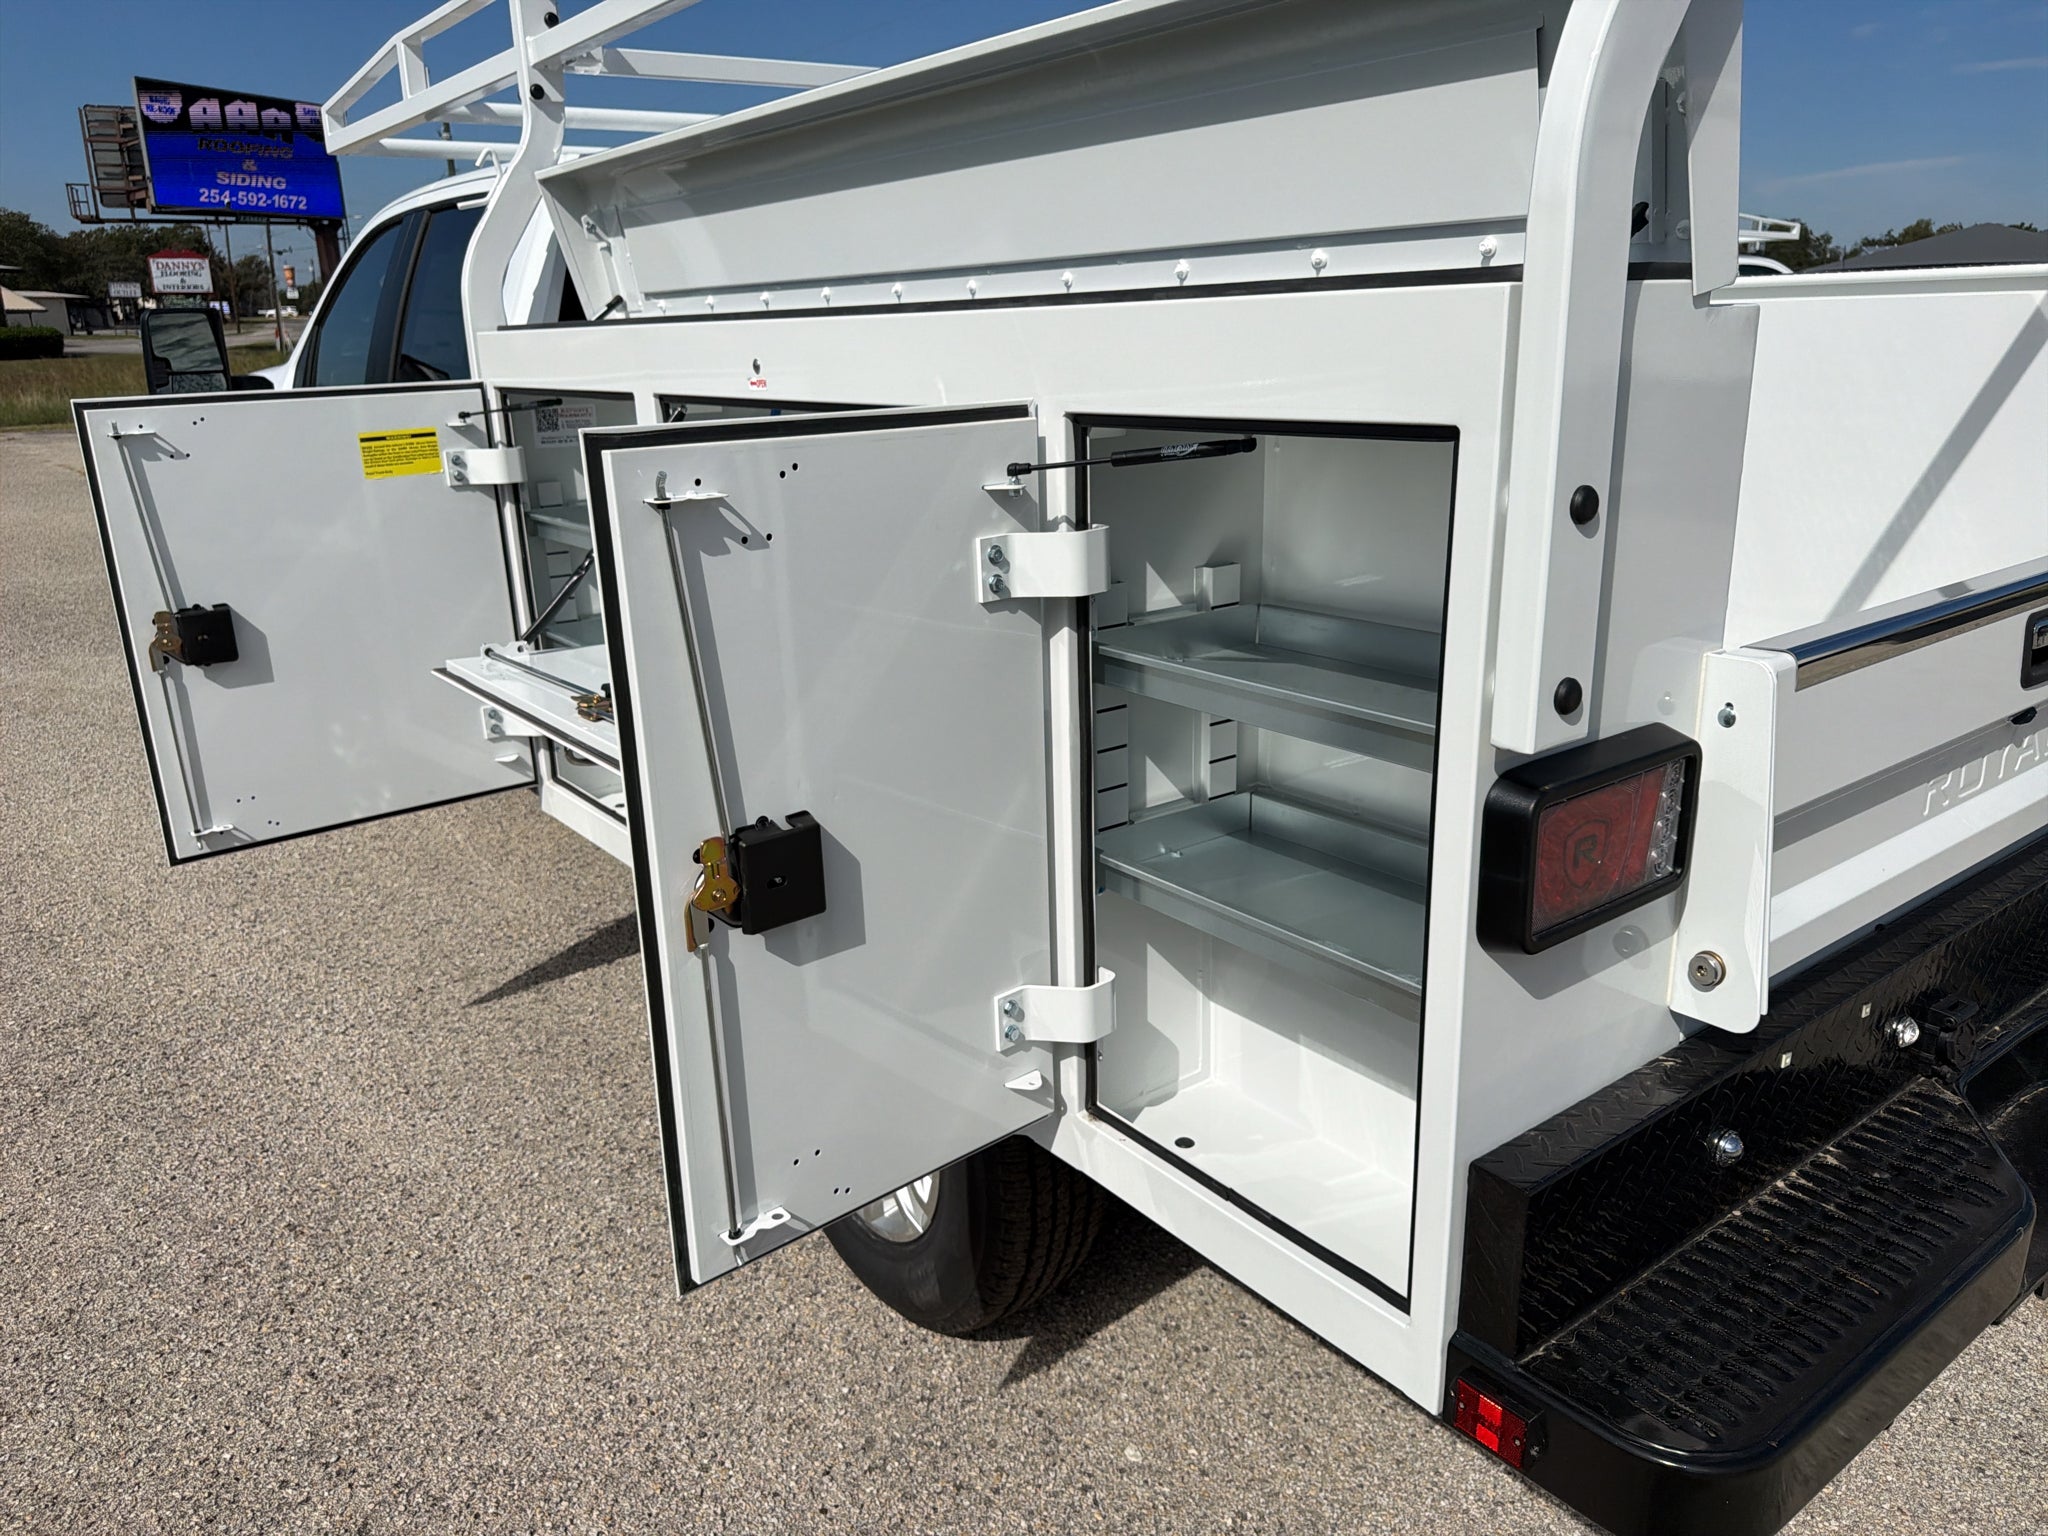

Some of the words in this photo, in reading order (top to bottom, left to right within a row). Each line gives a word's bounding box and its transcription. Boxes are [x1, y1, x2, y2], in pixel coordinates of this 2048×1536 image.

[242, 159, 257, 171] &
[216, 171, 286, 189] SIDING
[199, 188, 308, 210] 254-592-1672
